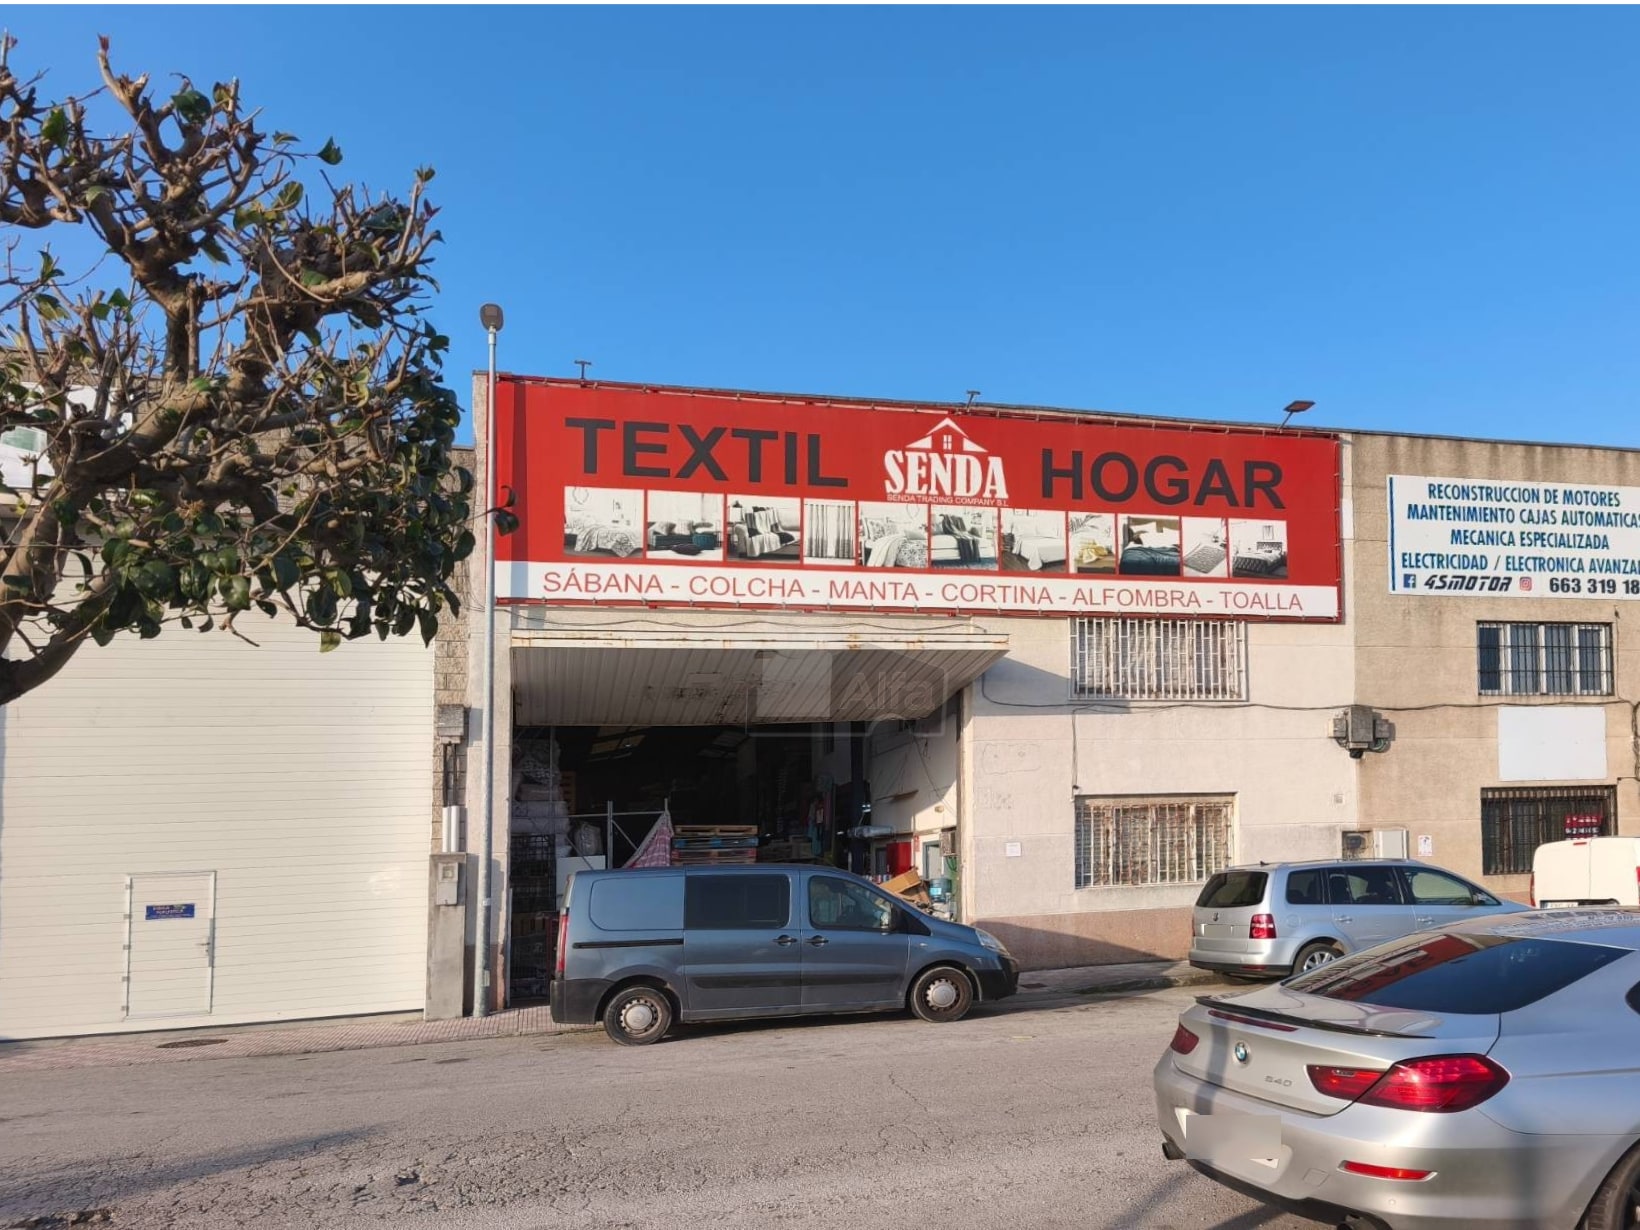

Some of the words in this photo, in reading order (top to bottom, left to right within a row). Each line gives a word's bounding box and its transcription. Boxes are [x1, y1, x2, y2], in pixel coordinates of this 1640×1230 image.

[565, 417, 848, 487] TEXTIL
[884, 449, 1009, 499] SENDA
[1041, 447, 1286, 509] HOGAR
[887, 493, 915, 502] SENDA
[916, 495, 953, 504] TRADING
[955, 497, 995, 506] COMPANY
[1428, 483, 1540, 503] RECONSTRUCCION
[1544, 488, 1559, 504] DE
[1563, 489, 1621, 507] MOTORES
[1407, 503, 1515, 524] MANTENIMIENTO
[1519, 508, 1557, 525] CAJAS
[1450, 529, 1516, 547] MECANICA
[1520, 531, 1610, 550] ESPECIALIZADA
[1401, 552, 1488, 571] ELECTRICIDAD
[1494, 555, 1501, 571] /
[1505, 555, 1585, 573] ELECTRONICA
[543, 567, 663, 594] SÁBANA
[689, 576, 805, 598] COLCHA
[829, 580, 919, 602] MANTA
[941, 582, 1052, 605] CORTINA
[1073, 587, 1201, 609] ALFOMBRA
[1220, 591, 1303, 611] TOALLA
[1549, 577, 1581, 594] 663
[1587, 578, 1617, 594] 319
